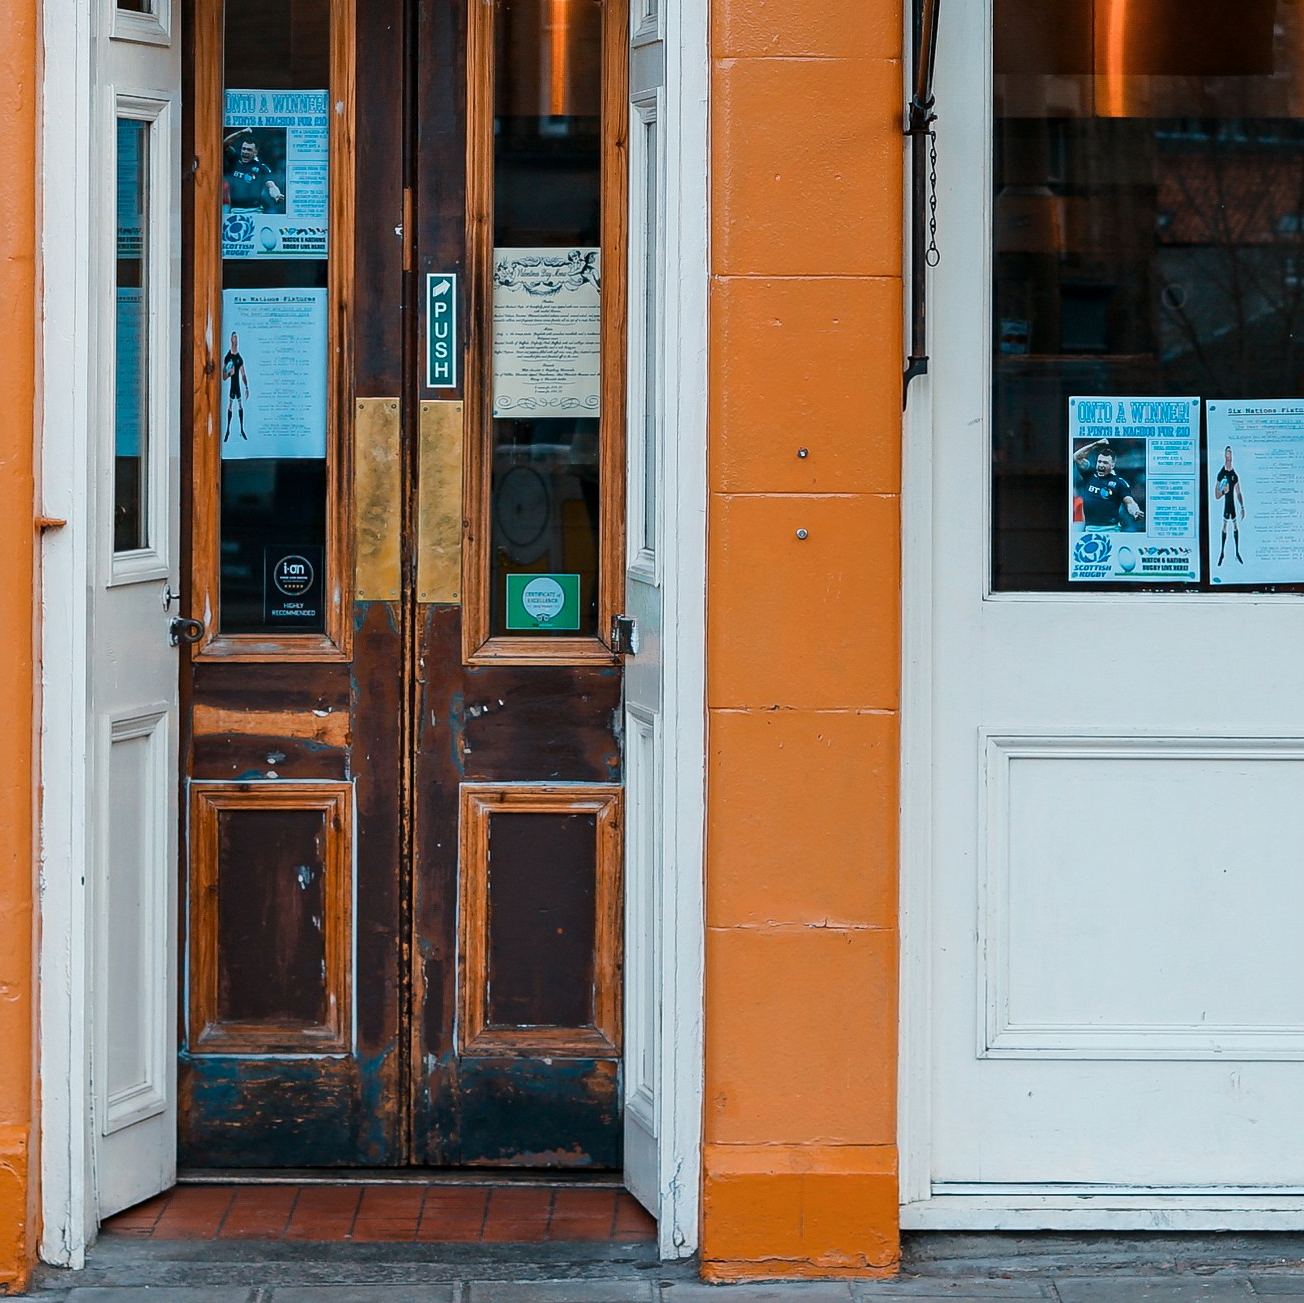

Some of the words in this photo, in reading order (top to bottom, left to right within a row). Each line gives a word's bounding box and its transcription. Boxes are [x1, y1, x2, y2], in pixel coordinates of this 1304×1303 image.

[225, 93, 255, 113] ONTO
[259, 93, 268, 113] A
[435, 302, 448, 378] PUSH
[1078, 402, 1112, 423] ONTO
[1116, 402, 1126, 423] A
[1130, 402, 1189, 423] WINNER!
[1088, 485, 1100, 493] BT
